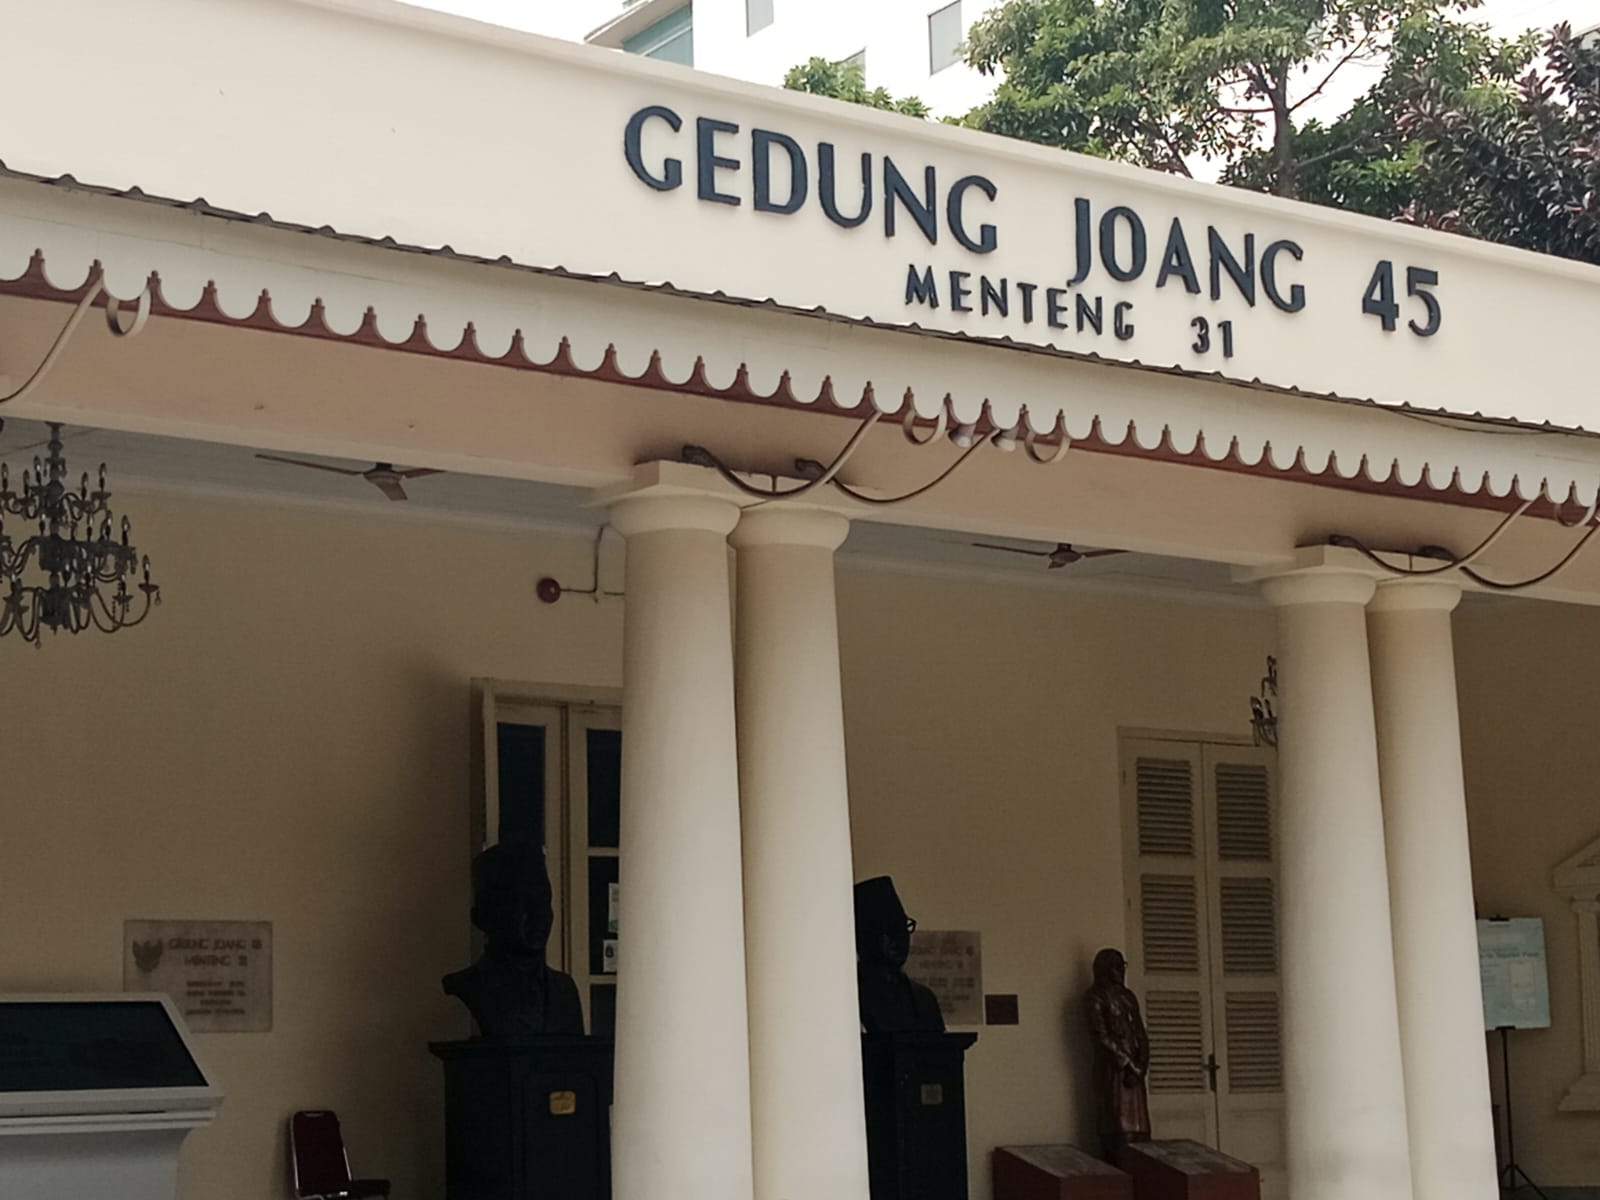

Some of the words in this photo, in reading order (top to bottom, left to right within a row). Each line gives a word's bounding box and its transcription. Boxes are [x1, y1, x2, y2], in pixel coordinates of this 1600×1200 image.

[624, 105, 998, 254] GEDUNG
[1067, 197, 1305, 313] JOANG
[1362, 260, 1441, 337] 45
[905, 264, 1134, 341] MENTENG
[1191, 316, 1233, 358] 31
